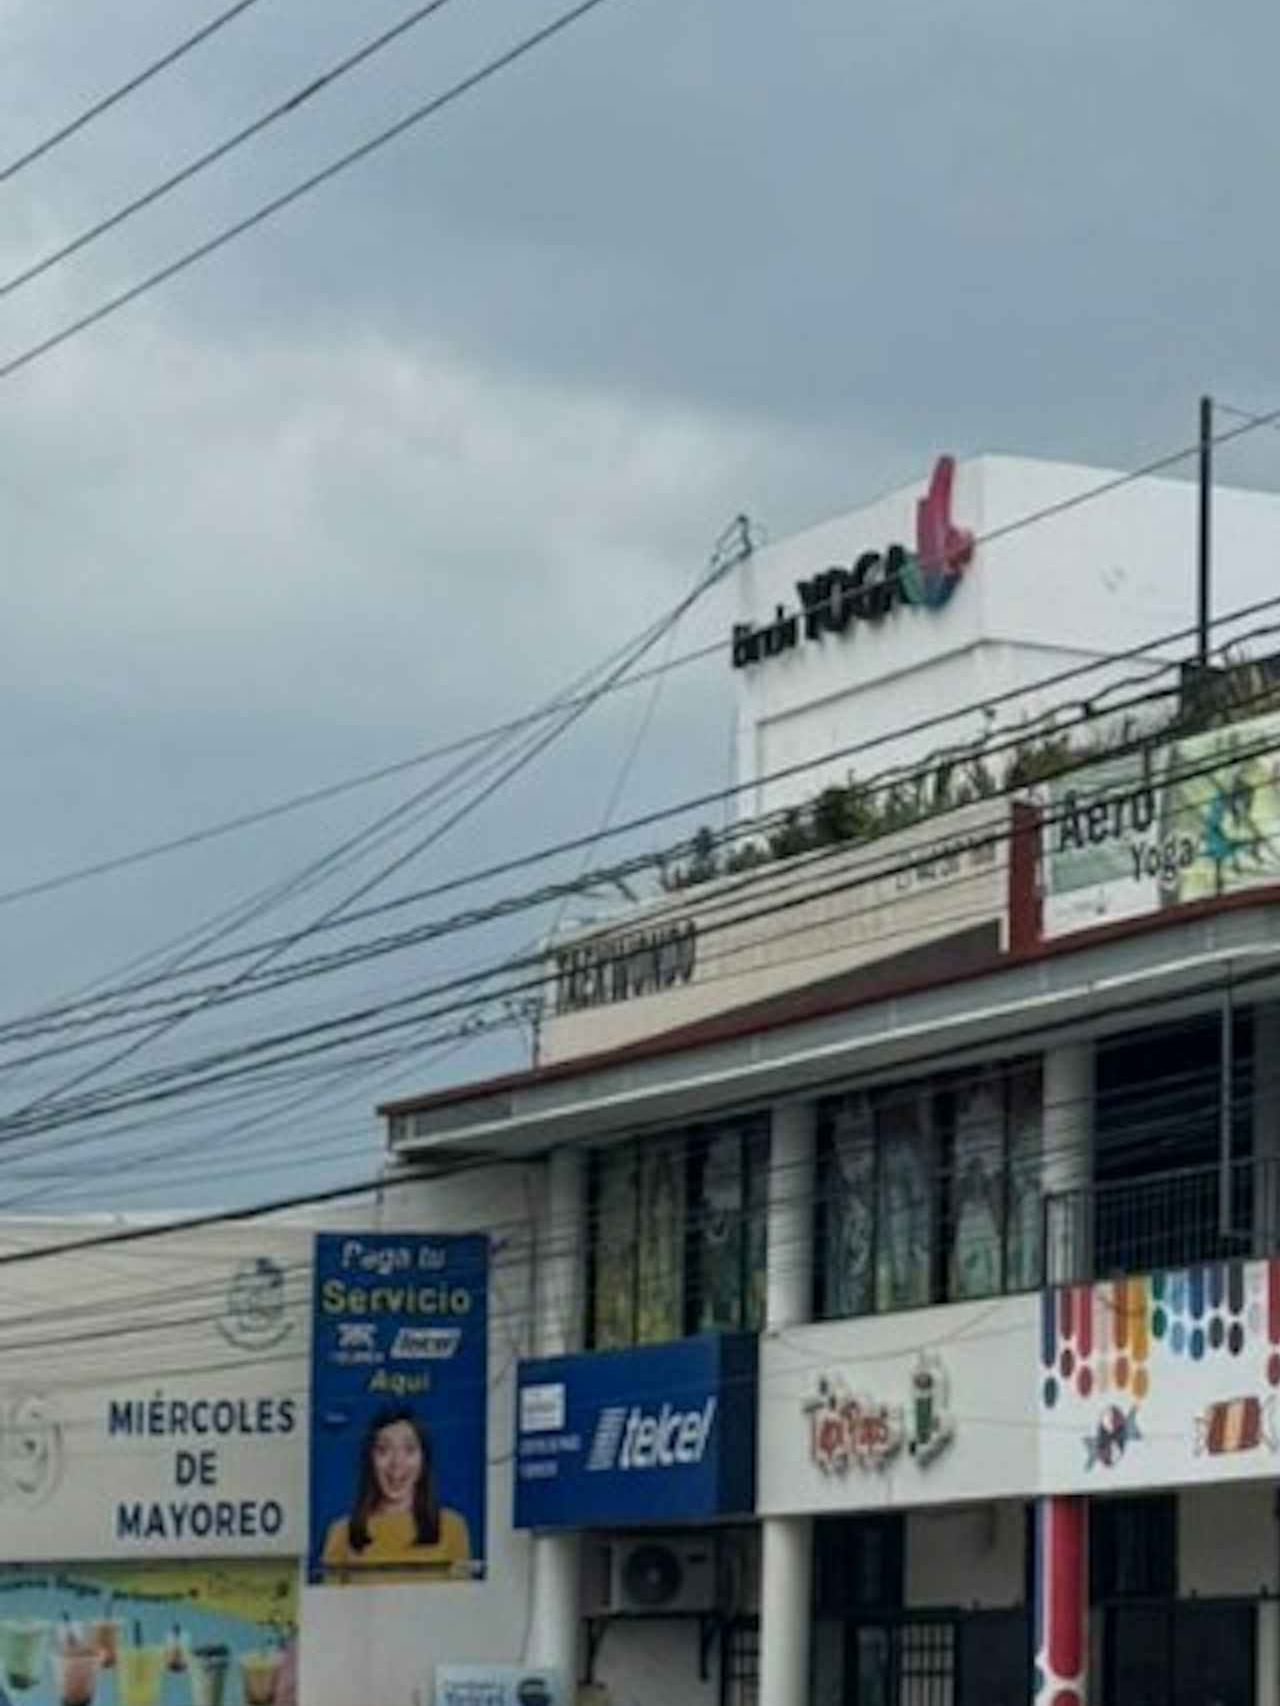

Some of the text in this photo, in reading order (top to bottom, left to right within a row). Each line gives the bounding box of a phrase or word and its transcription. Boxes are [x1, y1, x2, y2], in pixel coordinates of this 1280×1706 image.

[797, 544, 910, 641] YOGA
[1058, 790, 1154, 853] Aero
[1132, 837, 1194, 882] Yoga
[341, 1239, 448, 1275] Paga tu
[321, 1277, 473, 1316] Servicio
[108, 1389, 297, 1436] MIÉRCOLES
[618, 1396, 718, 1471] telcel
[175, 1450, 217, 1486] DE
[116, 1499, 283, 1539] MAYOREO
